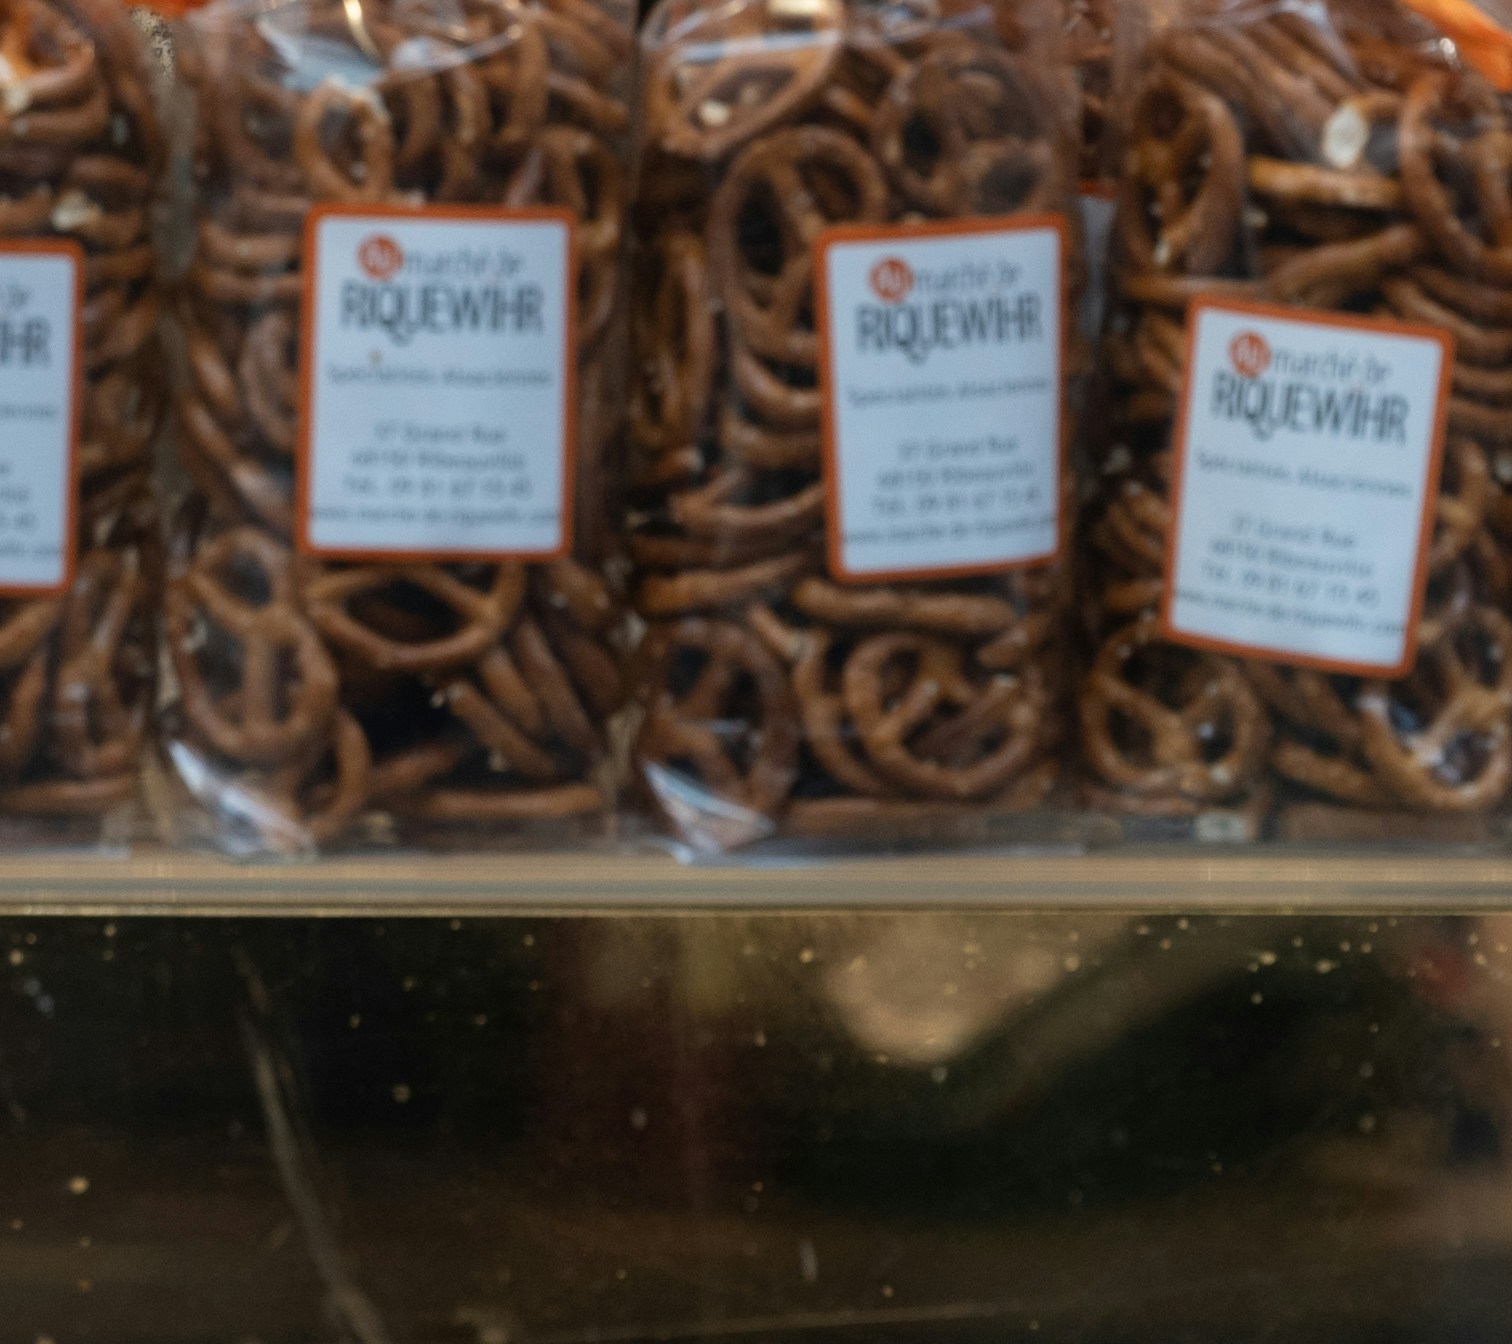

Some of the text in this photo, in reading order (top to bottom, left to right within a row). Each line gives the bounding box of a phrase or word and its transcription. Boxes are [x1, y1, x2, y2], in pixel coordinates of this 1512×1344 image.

[339, 279, 545, 348] RIQUEWIHR
[855, 291, 1043, 366] RIQUEWIHR
[1209, 368, 1411, 447] RIQUEWIHR
